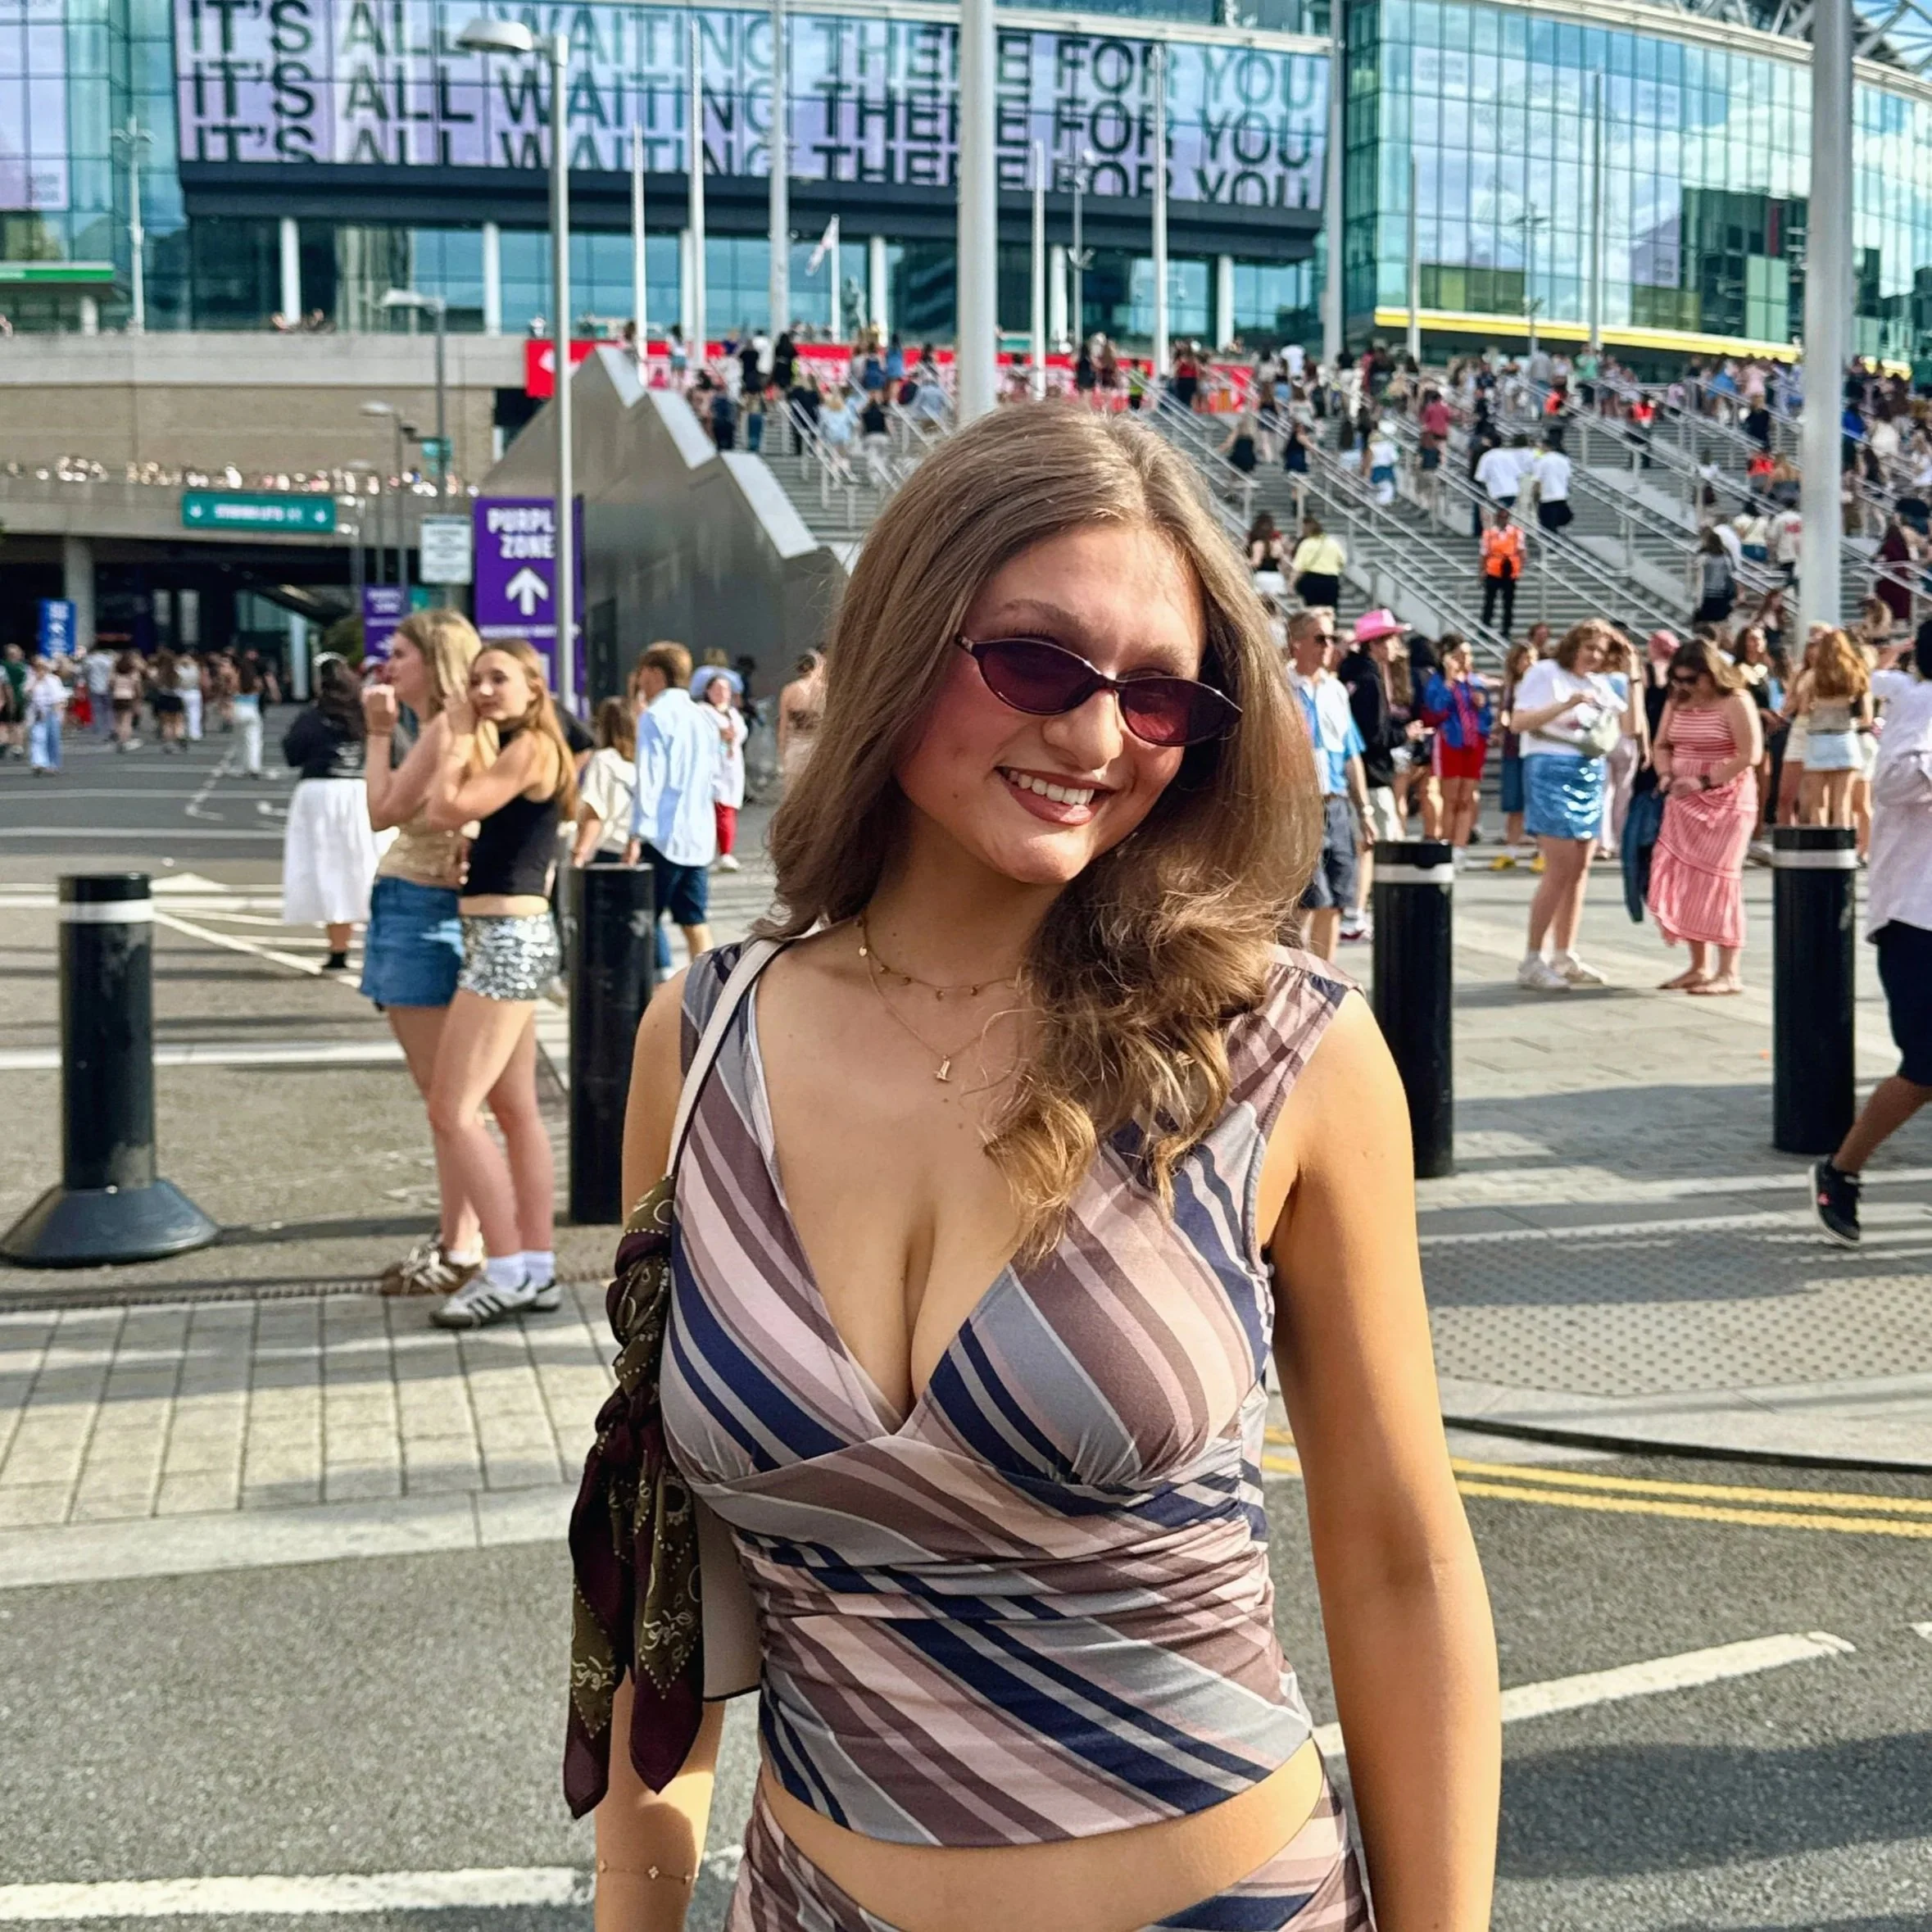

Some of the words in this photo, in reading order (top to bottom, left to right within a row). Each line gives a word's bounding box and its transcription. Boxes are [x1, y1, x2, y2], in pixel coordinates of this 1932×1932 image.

[342, 2, 472, 57] ALL
[813, 23, 1031, 87] THEE
[1057, 39, 1178, 98] FOR
[1199, 51, 1316, 110] YOU
[193, 61, 315, 119] IT'S
[344, 65, 475, 121] ALL
[500, 67, 785, 137] WAITING
[813, 83, 1030, 147] THEE
[1053, 98, 1174, 156] FOR
[1198, 108, 1313, 168] YOU
[812, 146, 1029, 190] THEE
[487, 507, 557, 533] PURPL
[500, 533, 556, 559] ZONE
